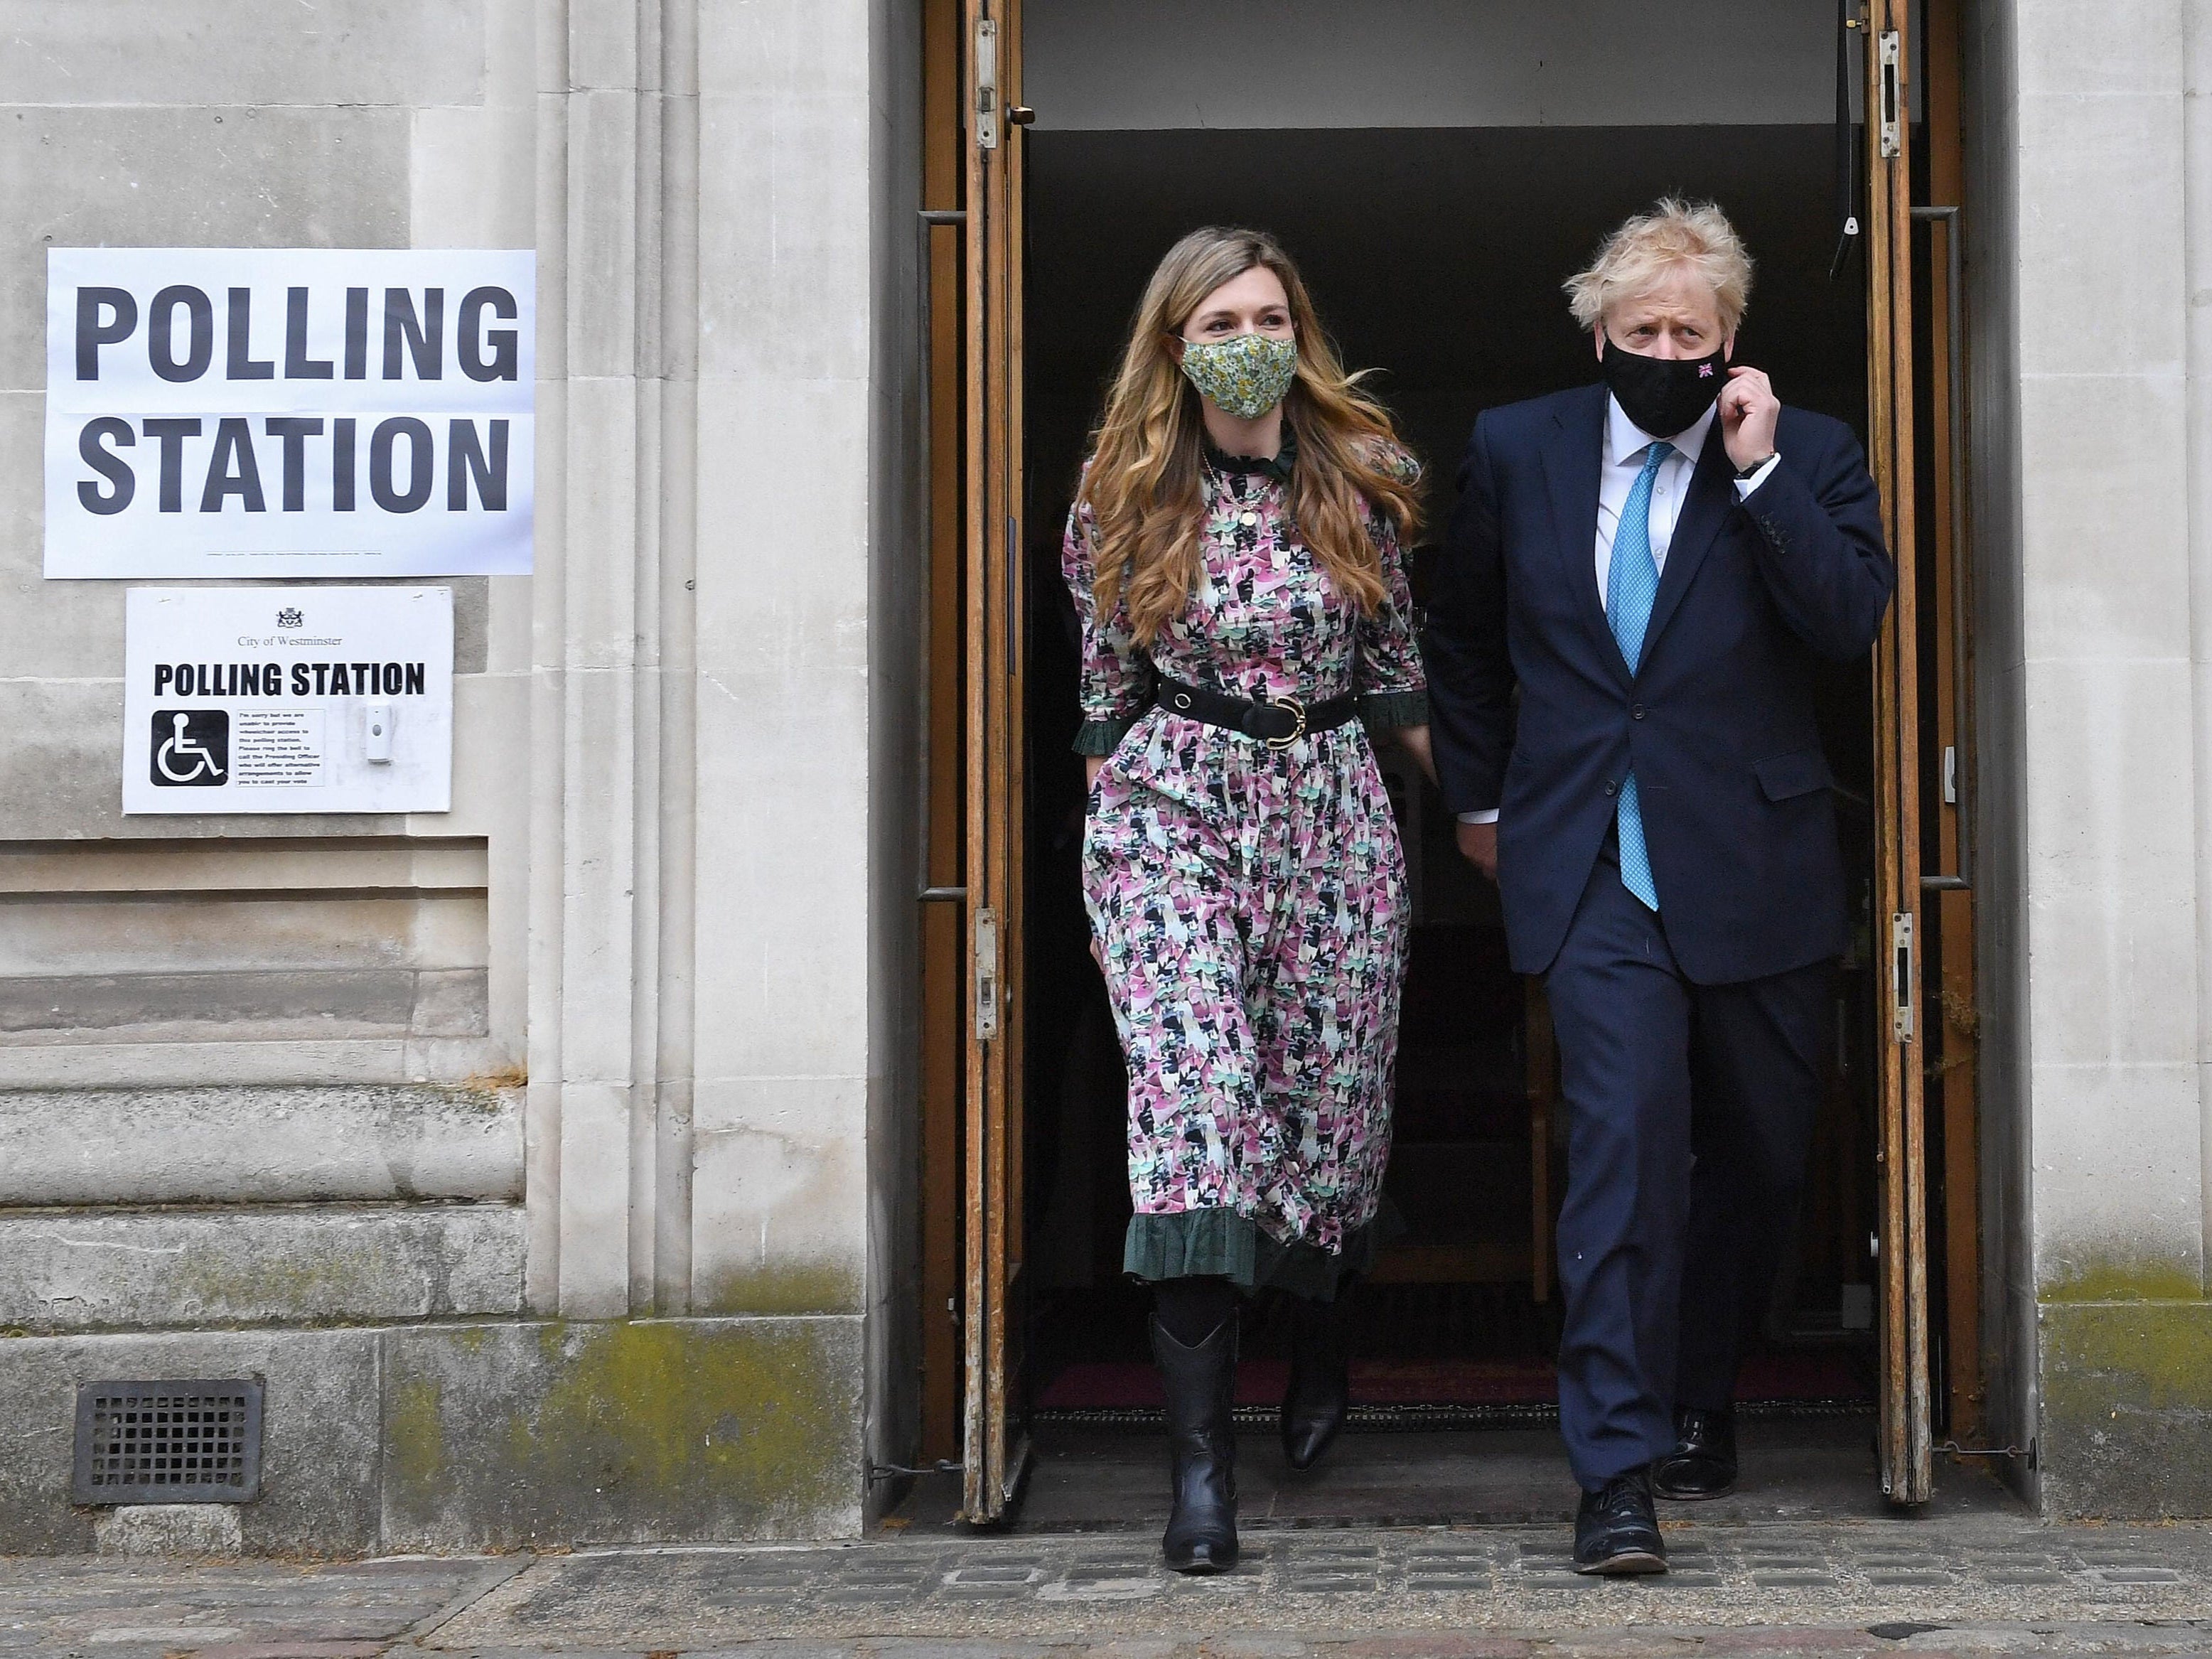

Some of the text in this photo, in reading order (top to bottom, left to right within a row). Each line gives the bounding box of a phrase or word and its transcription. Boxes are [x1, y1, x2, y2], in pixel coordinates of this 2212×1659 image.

[75, 284, 518, 382] POLLING
[76, 416, 510, 515] STATION
[237, 635, 343, 649] City of Westminster
[154, 662, 425, 697] POLLING STATION
